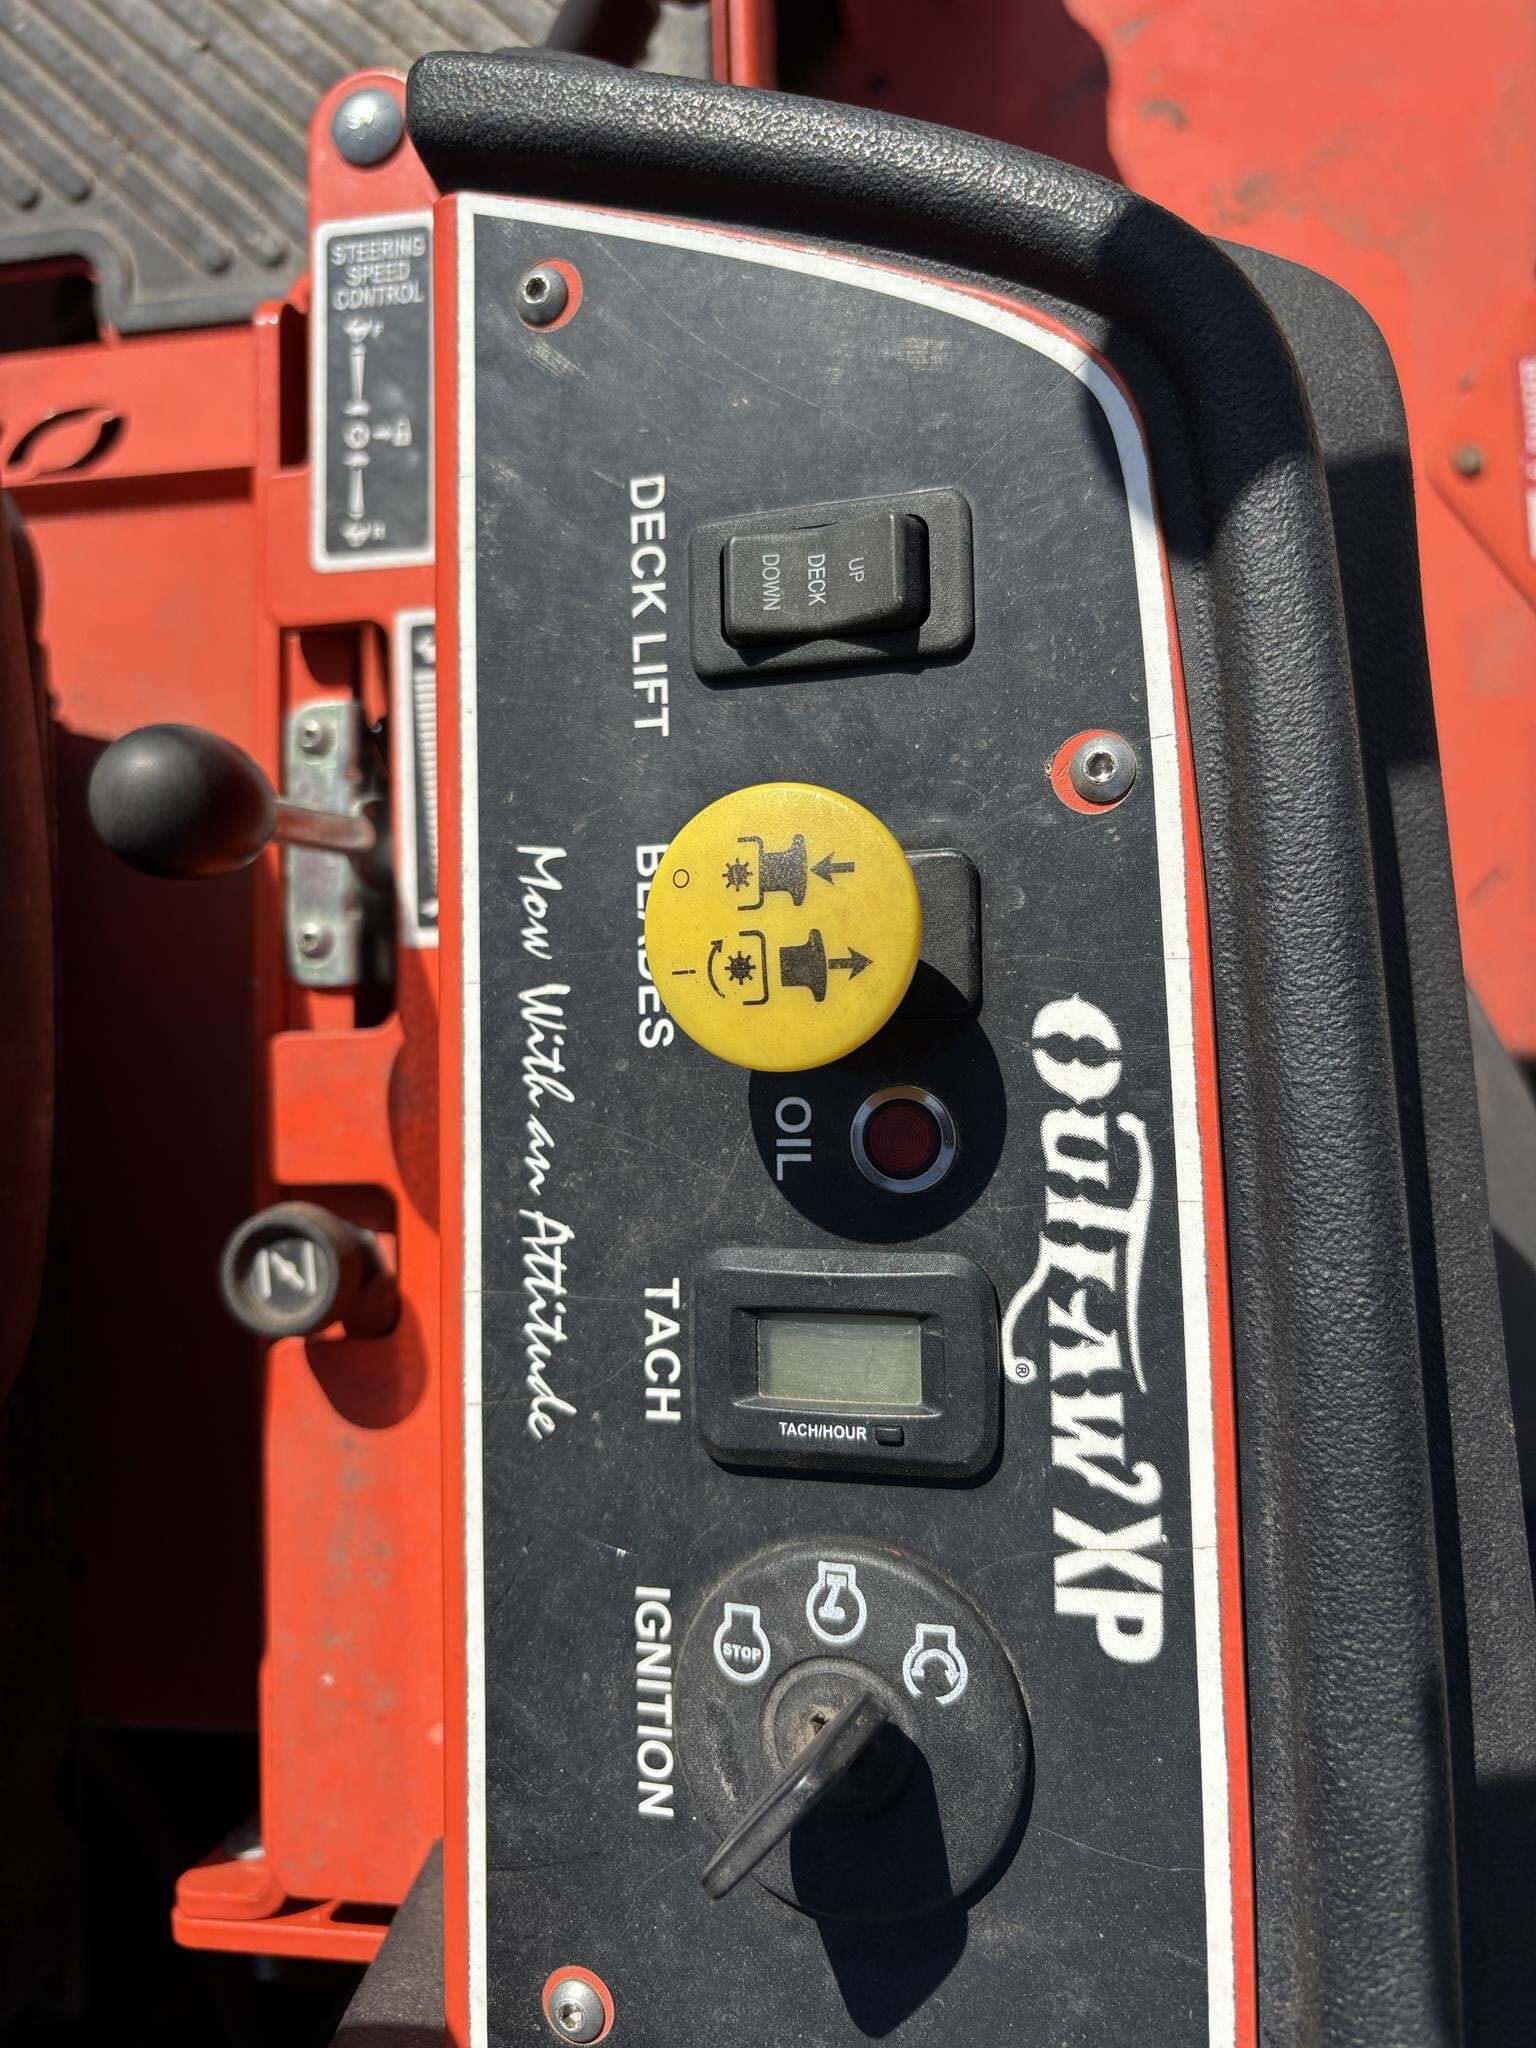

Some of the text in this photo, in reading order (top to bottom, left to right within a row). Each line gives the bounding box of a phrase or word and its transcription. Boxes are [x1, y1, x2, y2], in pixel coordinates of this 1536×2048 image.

[330, 234, 426, 266] STEERING
[344, 259, 411, 287] SPEED
[332, 281, 425, 311] CONTROL
[761, 553, 782, 612] DOWN
[807, 553, 826, 607] DECK
[848, 557, 865, 583] UP
[629, 474, 669, 737] DECK LIFT
[516, 846, 578, 1441] Mow With an Attitude
[775, 1096, 812, 1182] OIL
[644, 1277, 682, 1422] TACH
[779, 1421, 867, 1441] TACH/HOUR
[1052, 1506, 1164, 1664] XP
[722, 1642, 763, 1661] STOP
[635, 1585, 675, 1818] IGNITION
